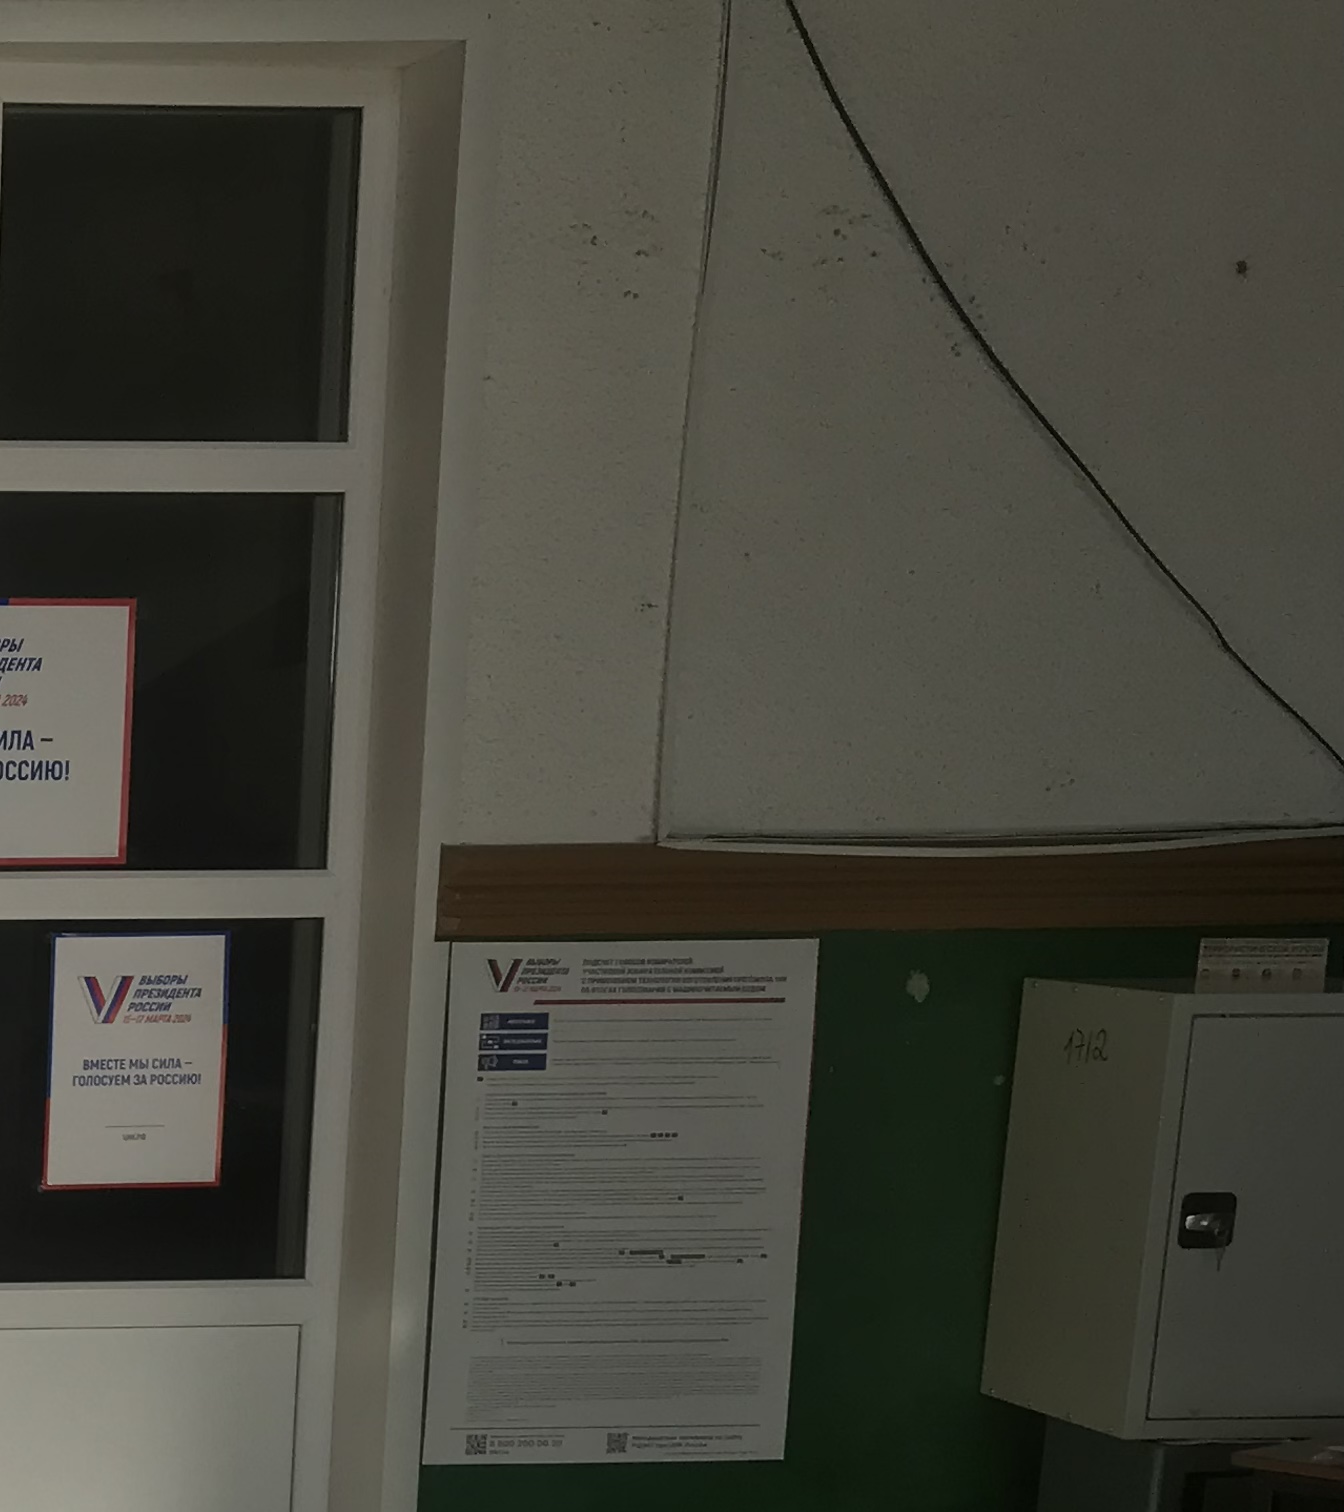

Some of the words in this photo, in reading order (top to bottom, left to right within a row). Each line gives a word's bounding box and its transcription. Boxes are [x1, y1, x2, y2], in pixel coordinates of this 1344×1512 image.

[2, 694, 28, 706] 2024
[138, 974, 188, 986] ВЫБОРЫ
[132, 988, 202, 1000] ПРЕЗИДЕНТА
[127, 1001, 172, 1012] РОССИИ
[82, 1058, 126, 1071] ВМЕСТЕ
[129, 1058, 149, 1070] МЫ
[152, 1057, 182, 1069] СИЛА
[72, 1074, 131, 1087] ГОЛОСУЕМ
[133, 1073, 148, 1086] ЗА
[150, 1072, 202, 1085] РОССИЮ!
